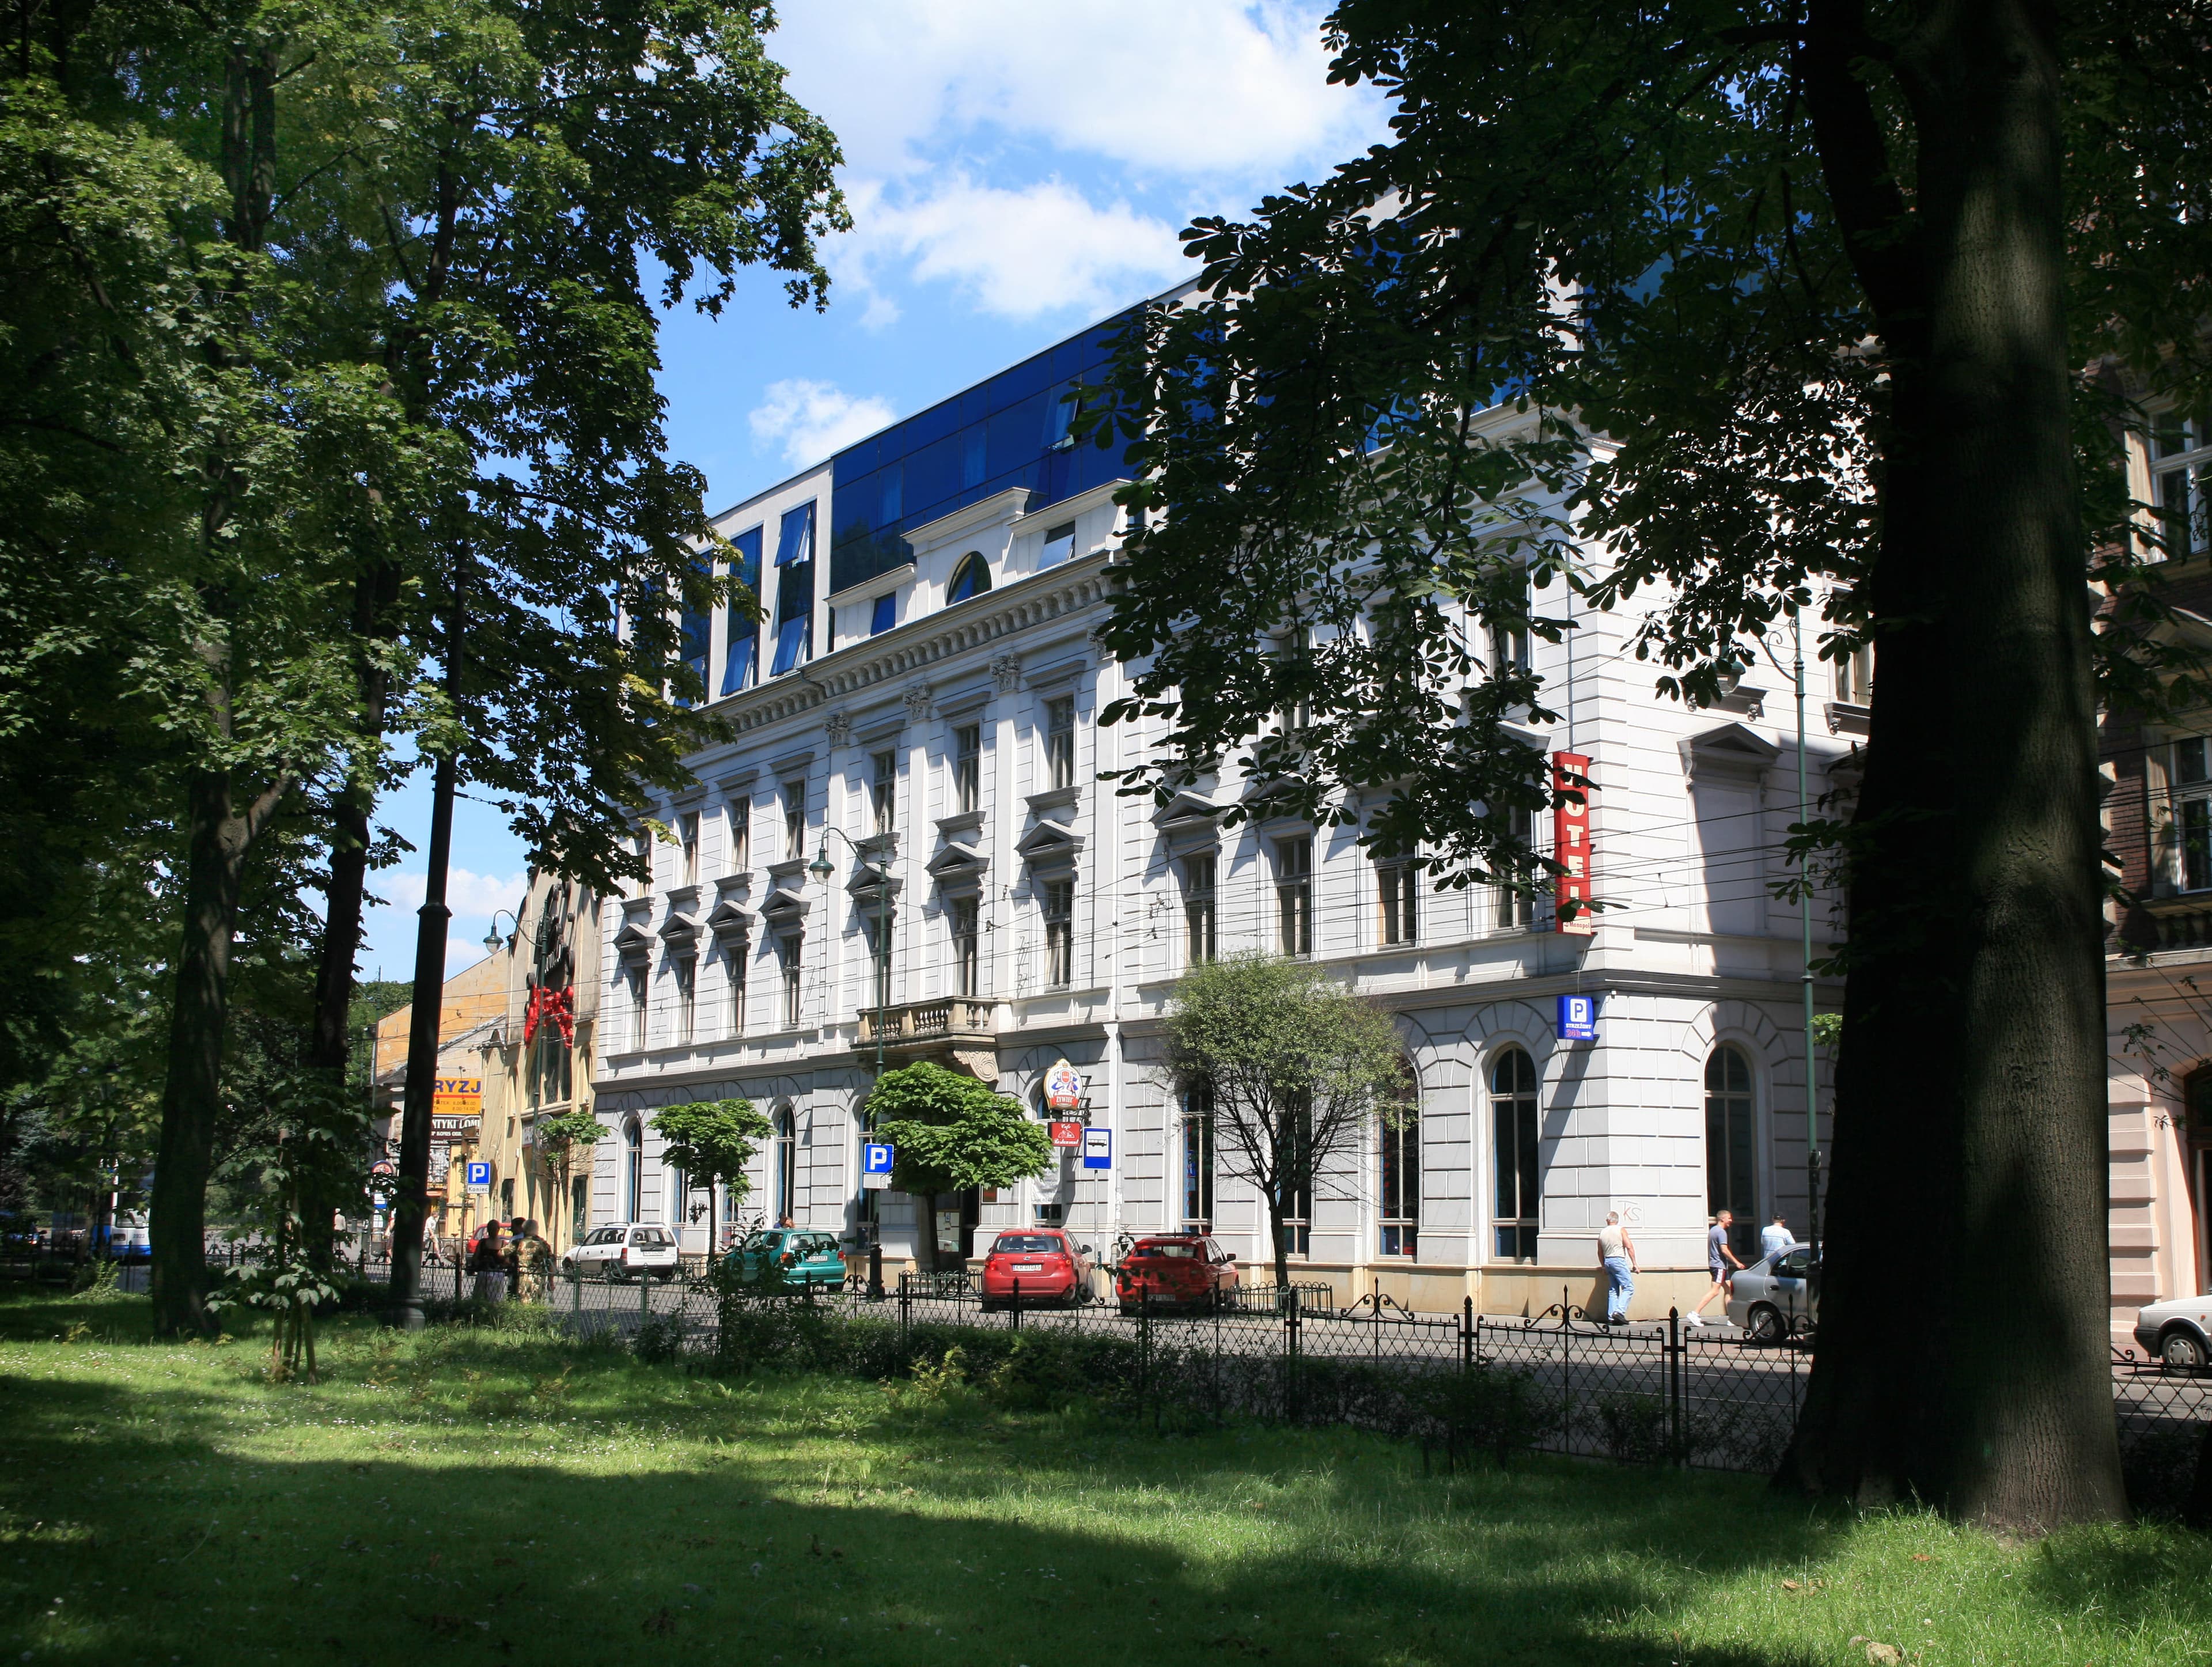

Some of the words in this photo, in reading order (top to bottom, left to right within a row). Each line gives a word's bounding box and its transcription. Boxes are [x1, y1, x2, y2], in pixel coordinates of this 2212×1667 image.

[1565, 763, 1585, 909] HOTEL
[1574, 1003, 1583, 1018] P
[870, 1147, 887, 1170] P
[472, 1165, 485, 1181] P
